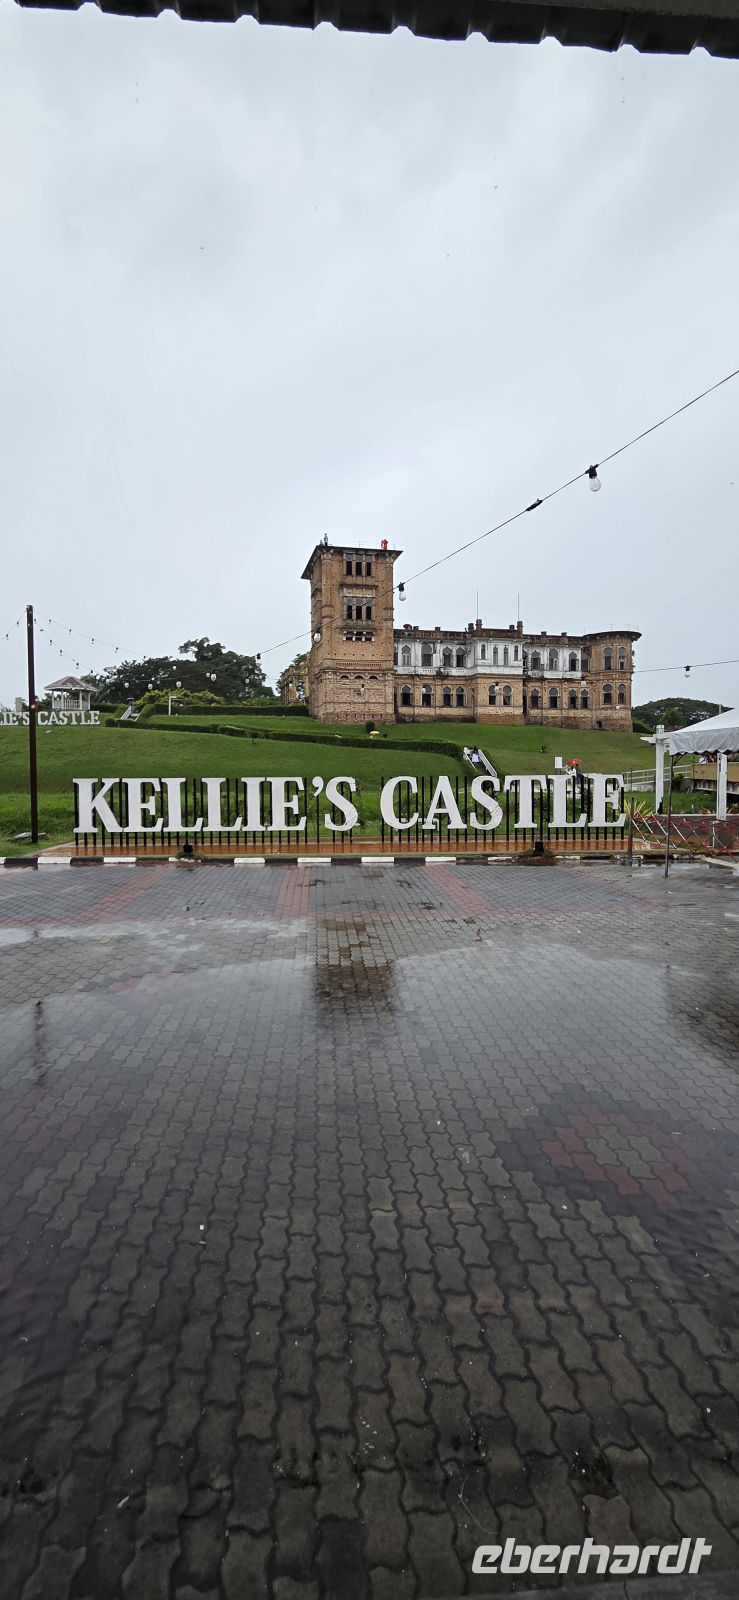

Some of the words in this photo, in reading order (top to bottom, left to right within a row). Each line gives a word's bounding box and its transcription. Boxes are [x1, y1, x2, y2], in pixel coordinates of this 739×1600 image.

[37, 710, 100, 726] CASTLE
[73, 776, 358, 833] KELLIE'S
[380, 775, 626, 830] CASTLE
